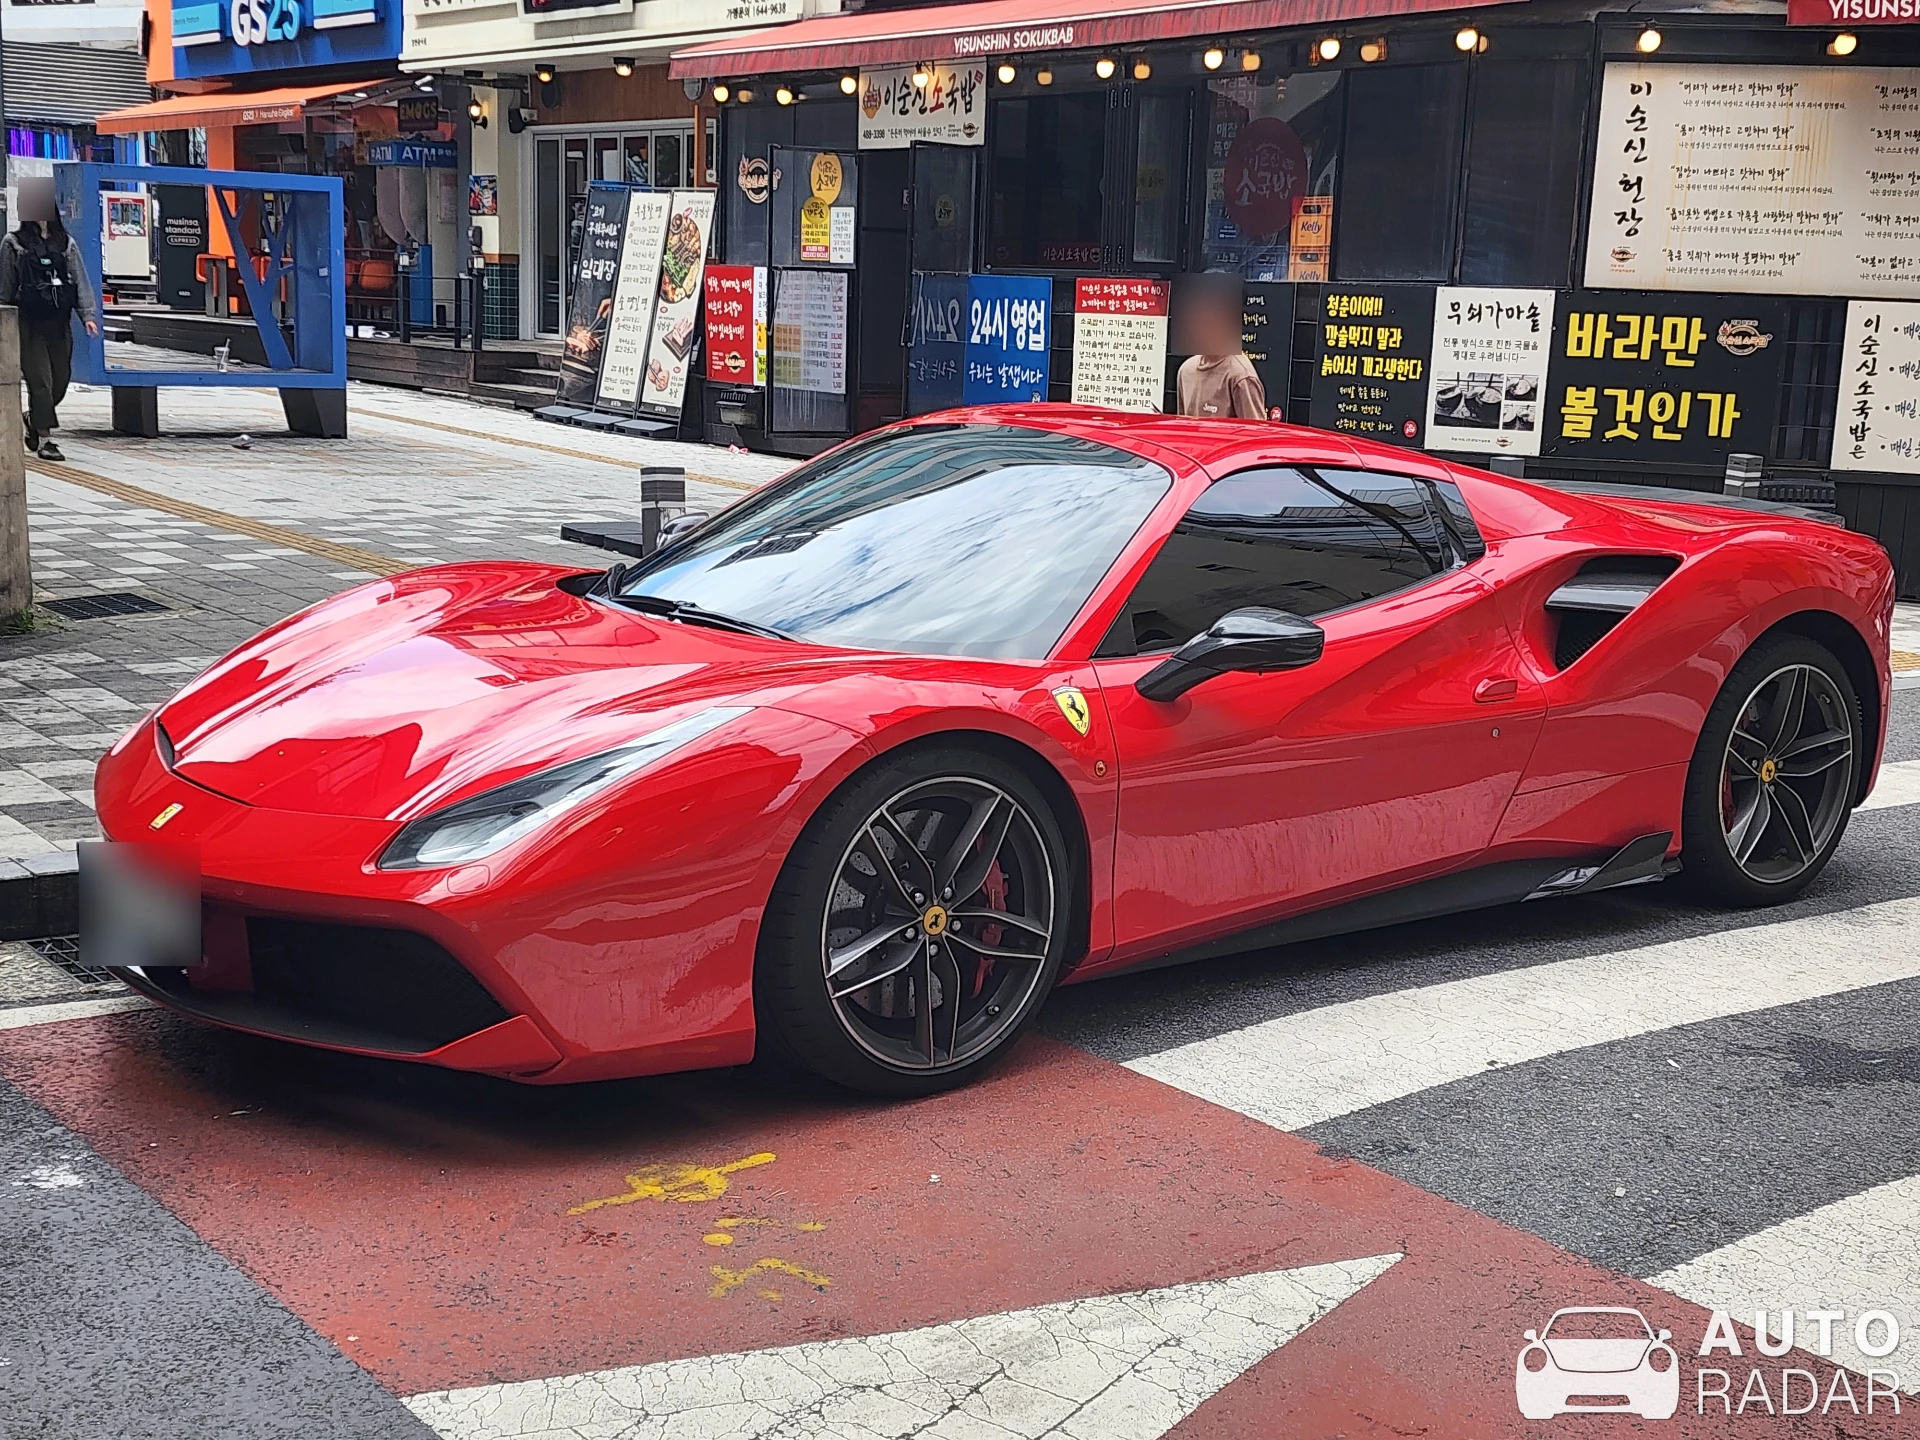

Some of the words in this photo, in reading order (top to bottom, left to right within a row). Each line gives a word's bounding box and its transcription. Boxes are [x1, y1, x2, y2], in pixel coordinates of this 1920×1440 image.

[753, 2, 786, 17] 1644-9638
[231, 0, 299, 46] GS25
[954, 33, 1011, 53] YISUNSHIN
[1013, 26, 1074, 48] SOKUKBAB
[1748, 82, 1773, 96] 말하지
[1892, 86, 1917, 100] 사람의
[1699, 124, 1731, 137] 약하다고
[1737, 125, 1768, 139] 고민하지
[375, 145, 392, 161] ATM
[402, 146, 436, 161] ATM
[167, 217, 199, 226] musinsa
[1703, 208, 1733, 222] 방법으로
[1736, 209, 1759, 224] 가족을
[1762, 210, 1793, 223] 사랑한다
[1796, 211, 1819, 225] 말하지
[165, 226, 201, 235] standard
[1300, 220, 1322, 234] Kelly
[1326, 294, 1383, 319] 청춘이여!!
[1447, 300, 1541, 333] 무쇠가마솥
[970, 299, 1046, 351] 24시영업
[1107, 329, 1126, 339] 하나도
[1324, 324, 1373, 349] 깡술먹지
[1376, 325, 1403, 350] 말라
[1566, 313, 1707, 368] 바라만
[1461, 337, 1493, 349] 방식으로
[1495, 339, 1512, 350] 진한
[1452, 350, 1477, 361] 제대로
[969, 362, 994, 384] 우리는
[1123, 364, 1136, 373] 고기
[1321, 354, 1357, 377] 늙어서
[1362, 355, 1423, 381] 개고생한다
[1560, 386, 1741, 441] 볼것인가
[1894, 398, 1917, 419] 매일
[1890, 437, 1913, 458] 매일
